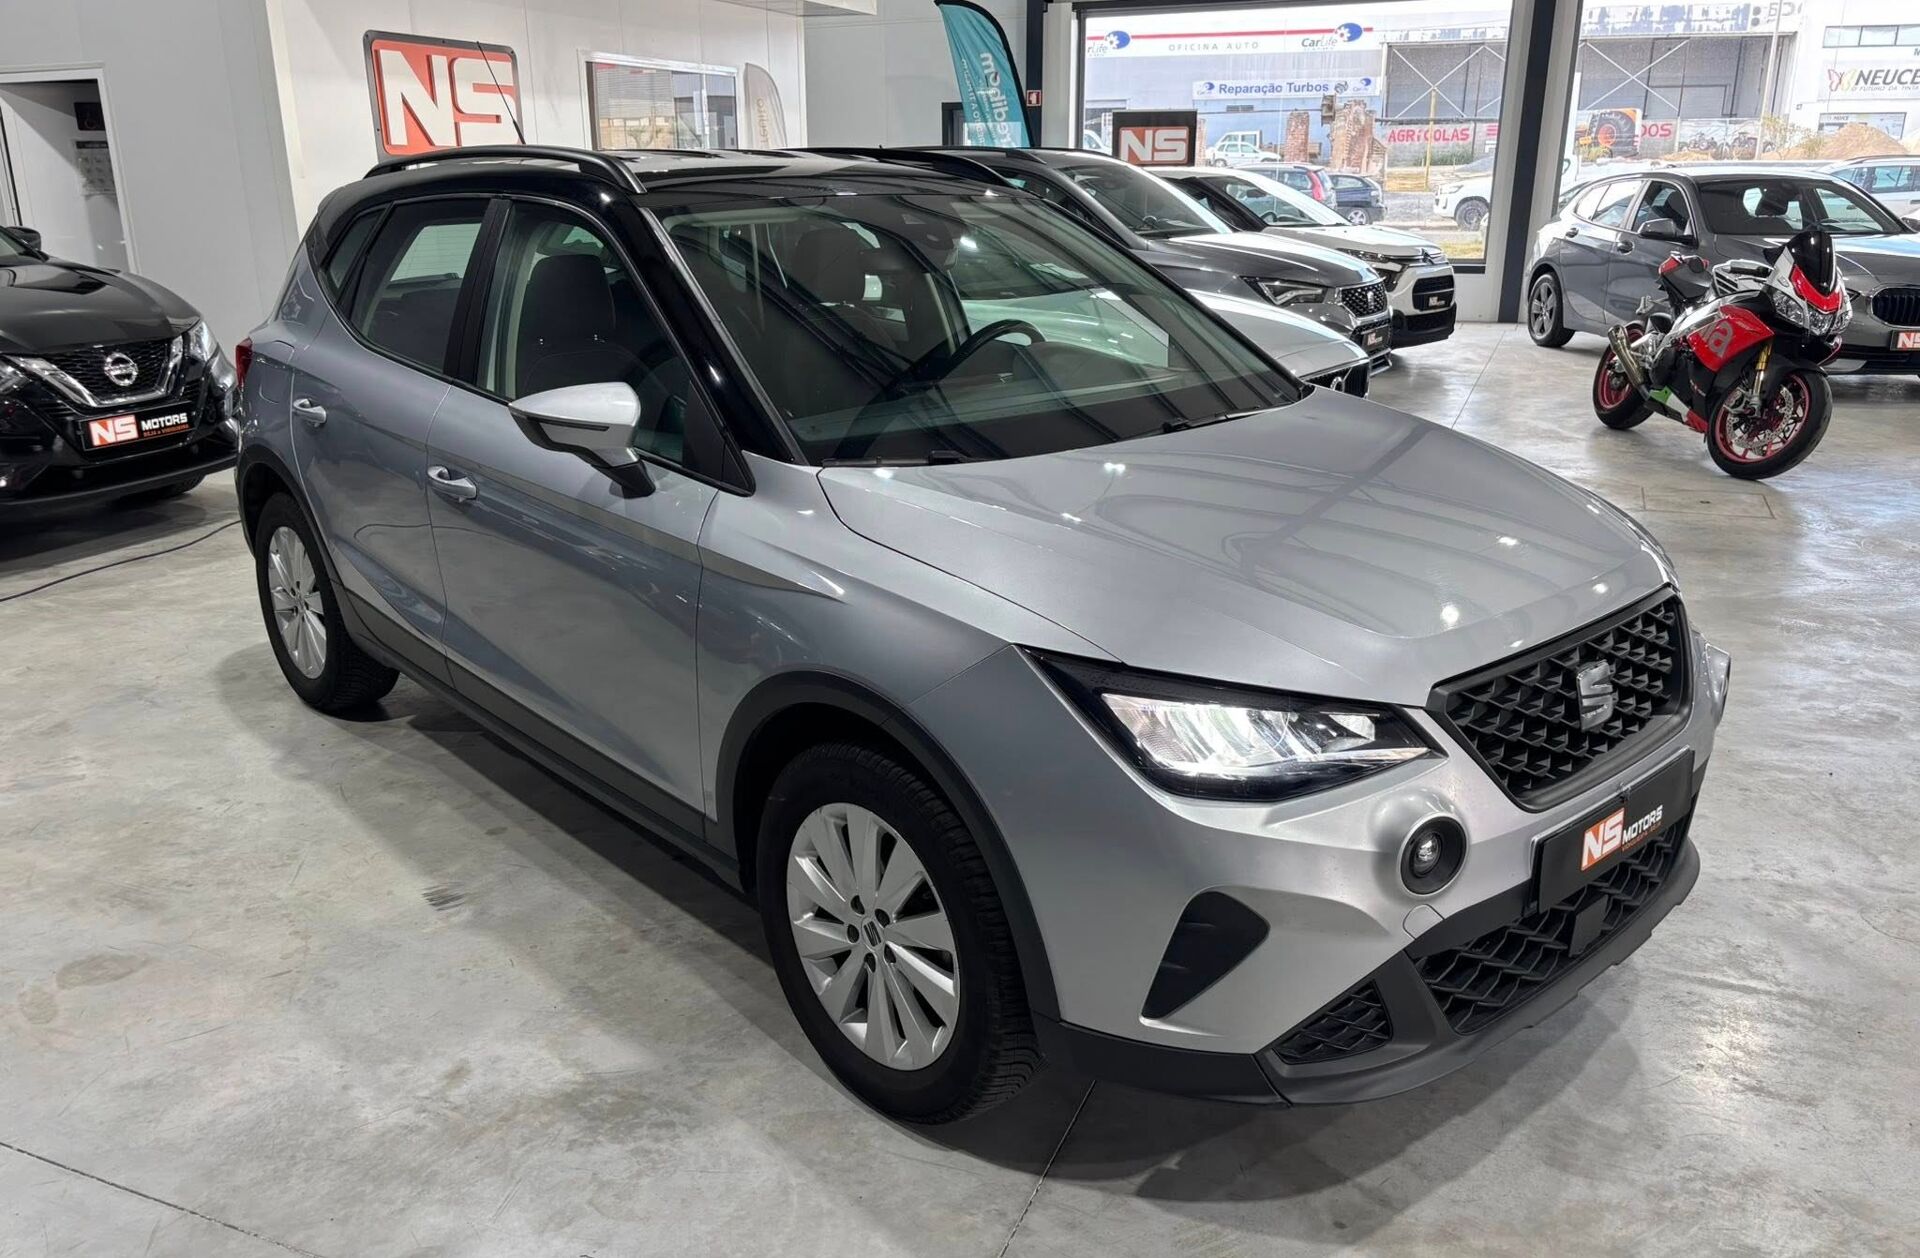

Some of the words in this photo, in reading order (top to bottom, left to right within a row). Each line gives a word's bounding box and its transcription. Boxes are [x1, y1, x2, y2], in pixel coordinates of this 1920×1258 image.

[1168, 43, 1218, 51] OFICINA
[1226, 42, 1259, 50] AUTO
[379, 49, 518, 146] NS
[1218, 83, 1283, 96] Reparação
[1286, 82, 1329, 93] Turbos
[1121, 129, 1187, 161] NS
[89, 414, 139, 446] NS
[141, 412, 188, 431] MOTORS
[1581, 809, 1625, 871] NS
[1622, 804, 1663, 845] MOTORS
